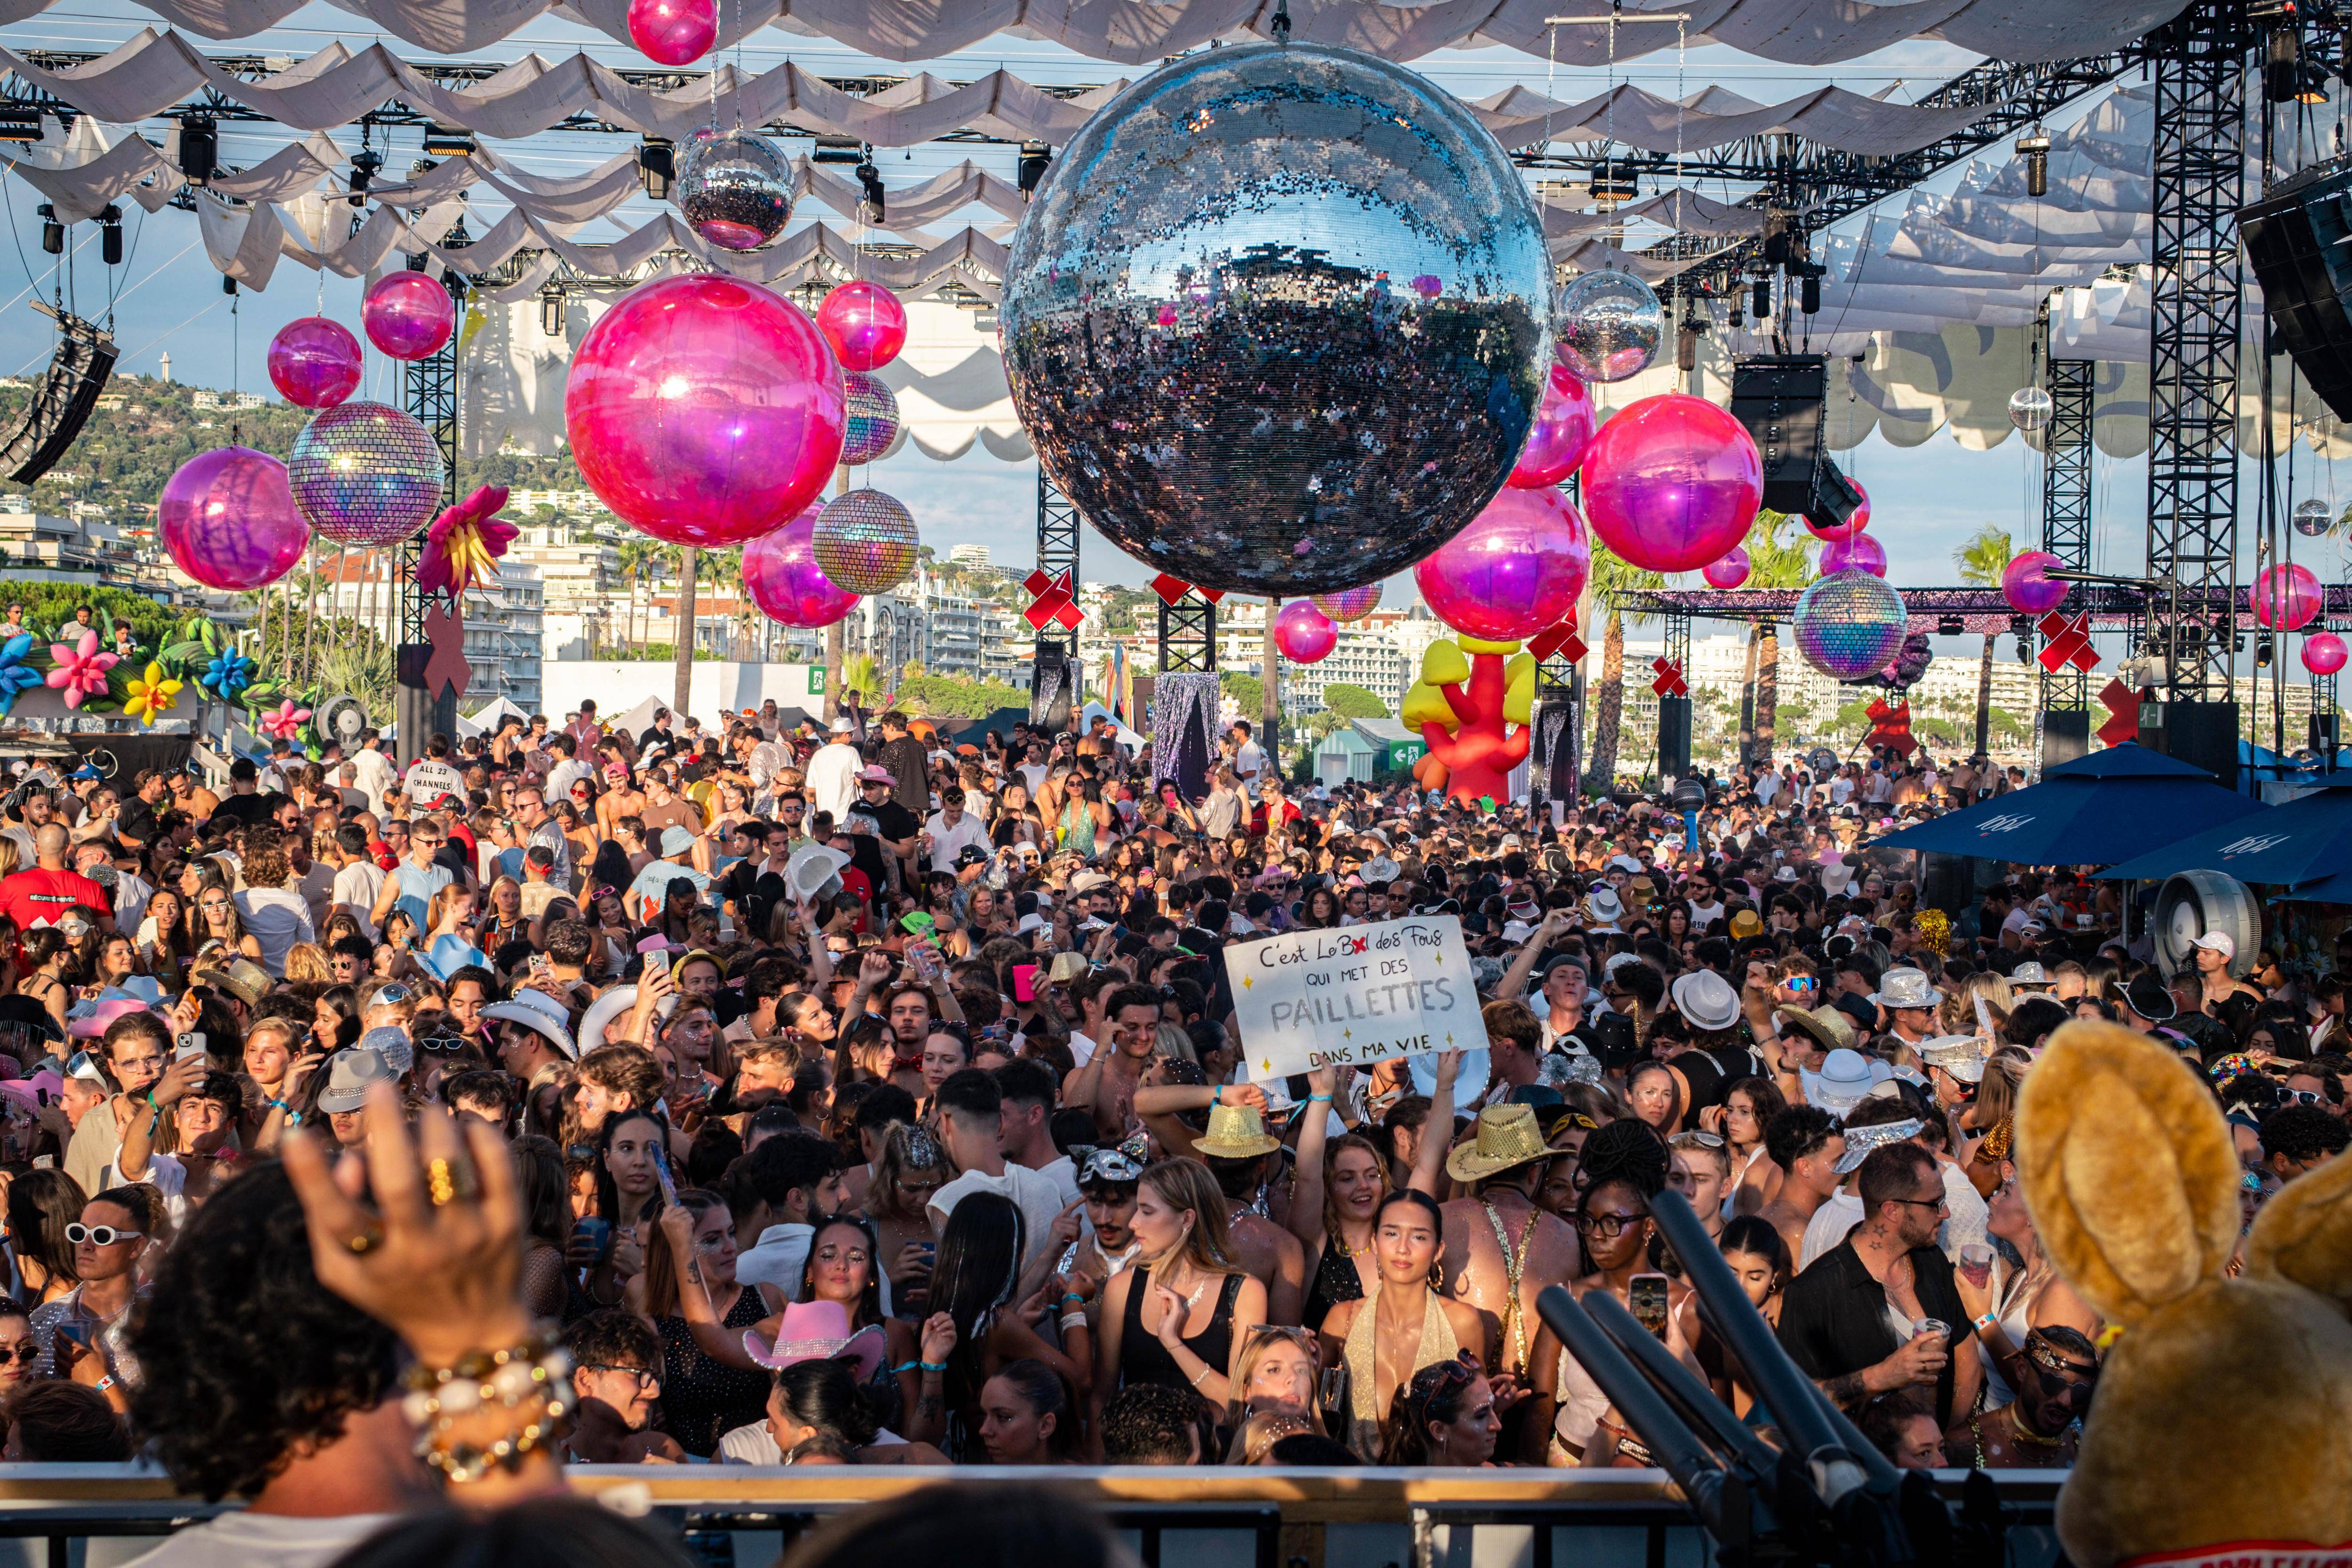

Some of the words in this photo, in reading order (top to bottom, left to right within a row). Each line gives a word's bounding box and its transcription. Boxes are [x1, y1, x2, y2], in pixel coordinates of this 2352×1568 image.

[413, 779, 451, 790] CHANNELS
[1975, 813, 2036, 832] 1664
[2217, 834, 2291, 854] 1664
[1260, 943, 1308, 967] C'est
[1317, 938, 1336, 960] Le
[1376, 931, 1401, 949] des
[1401, 925, 1443, 947] Fous
[1306, 973, 1330, 986] QUI
[1342, 966, 1368, 982] MET
[1381, 959, 1408, 976] DES
[1271, 977, 1454, 1033] PAILLETTES
[1310, 1047, 1352, 1067] DANS
[1362, 1042, 1387, 1059] MA
[1395, 1035, 1432, 1051] VIE
